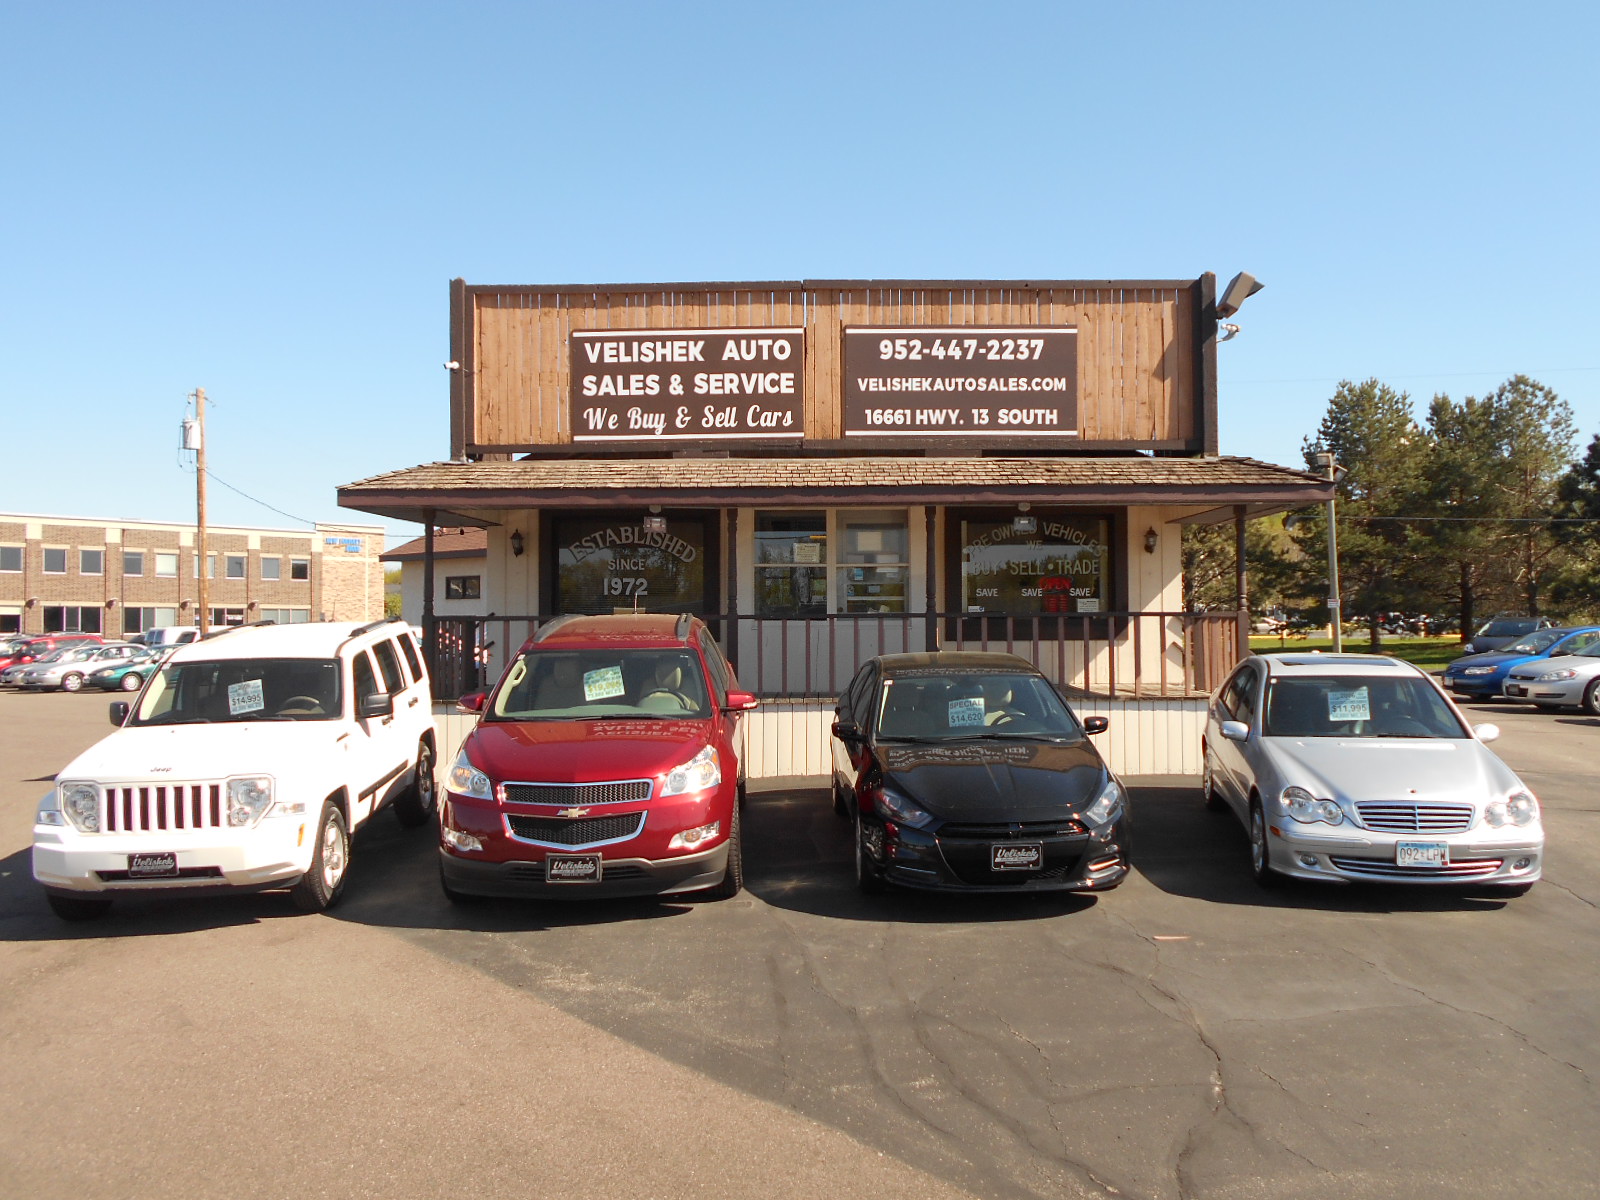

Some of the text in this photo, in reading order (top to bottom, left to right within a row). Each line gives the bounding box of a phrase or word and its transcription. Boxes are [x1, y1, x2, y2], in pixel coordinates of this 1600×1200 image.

[584, 338, 792, 363] VELISHEK AUTO
[879, 338, 1044, 361] 952-447-2237
[582, 371, 795, 396] SALES & SERVICE
[857, 377, 1066, 392] VELISHEKAUTOSALES.COM
[583, 404, 793, 435] We Buy & Sell Cars
[865, 408, 1058, 426] 16661 HWY. 13 SOUTH
[568, 526, 697, 563] ESTABLISHED
[968, 534, 993, 556] PRE
[1043, 522, 1102, 557] VEHICLES
[1026, 540, 1043, 551] WE
[608, 559, 645, 571] SINCE
[973, 560, 1100, 576] BUY SELL TRADE
[603, 577, 648, 596] 1972
[976, 588, 998, 597] SAVE
[1021, 588, 1043, 597] SAVE
[1069, 587, 1092, 597] SAVE
[231, 693, 262, 706] $14,995
[950, 700, 983, 710] SPECIAL
[1332, 703, 1367, 713] $11,995
[951, 712, 983, 724] $14,620
